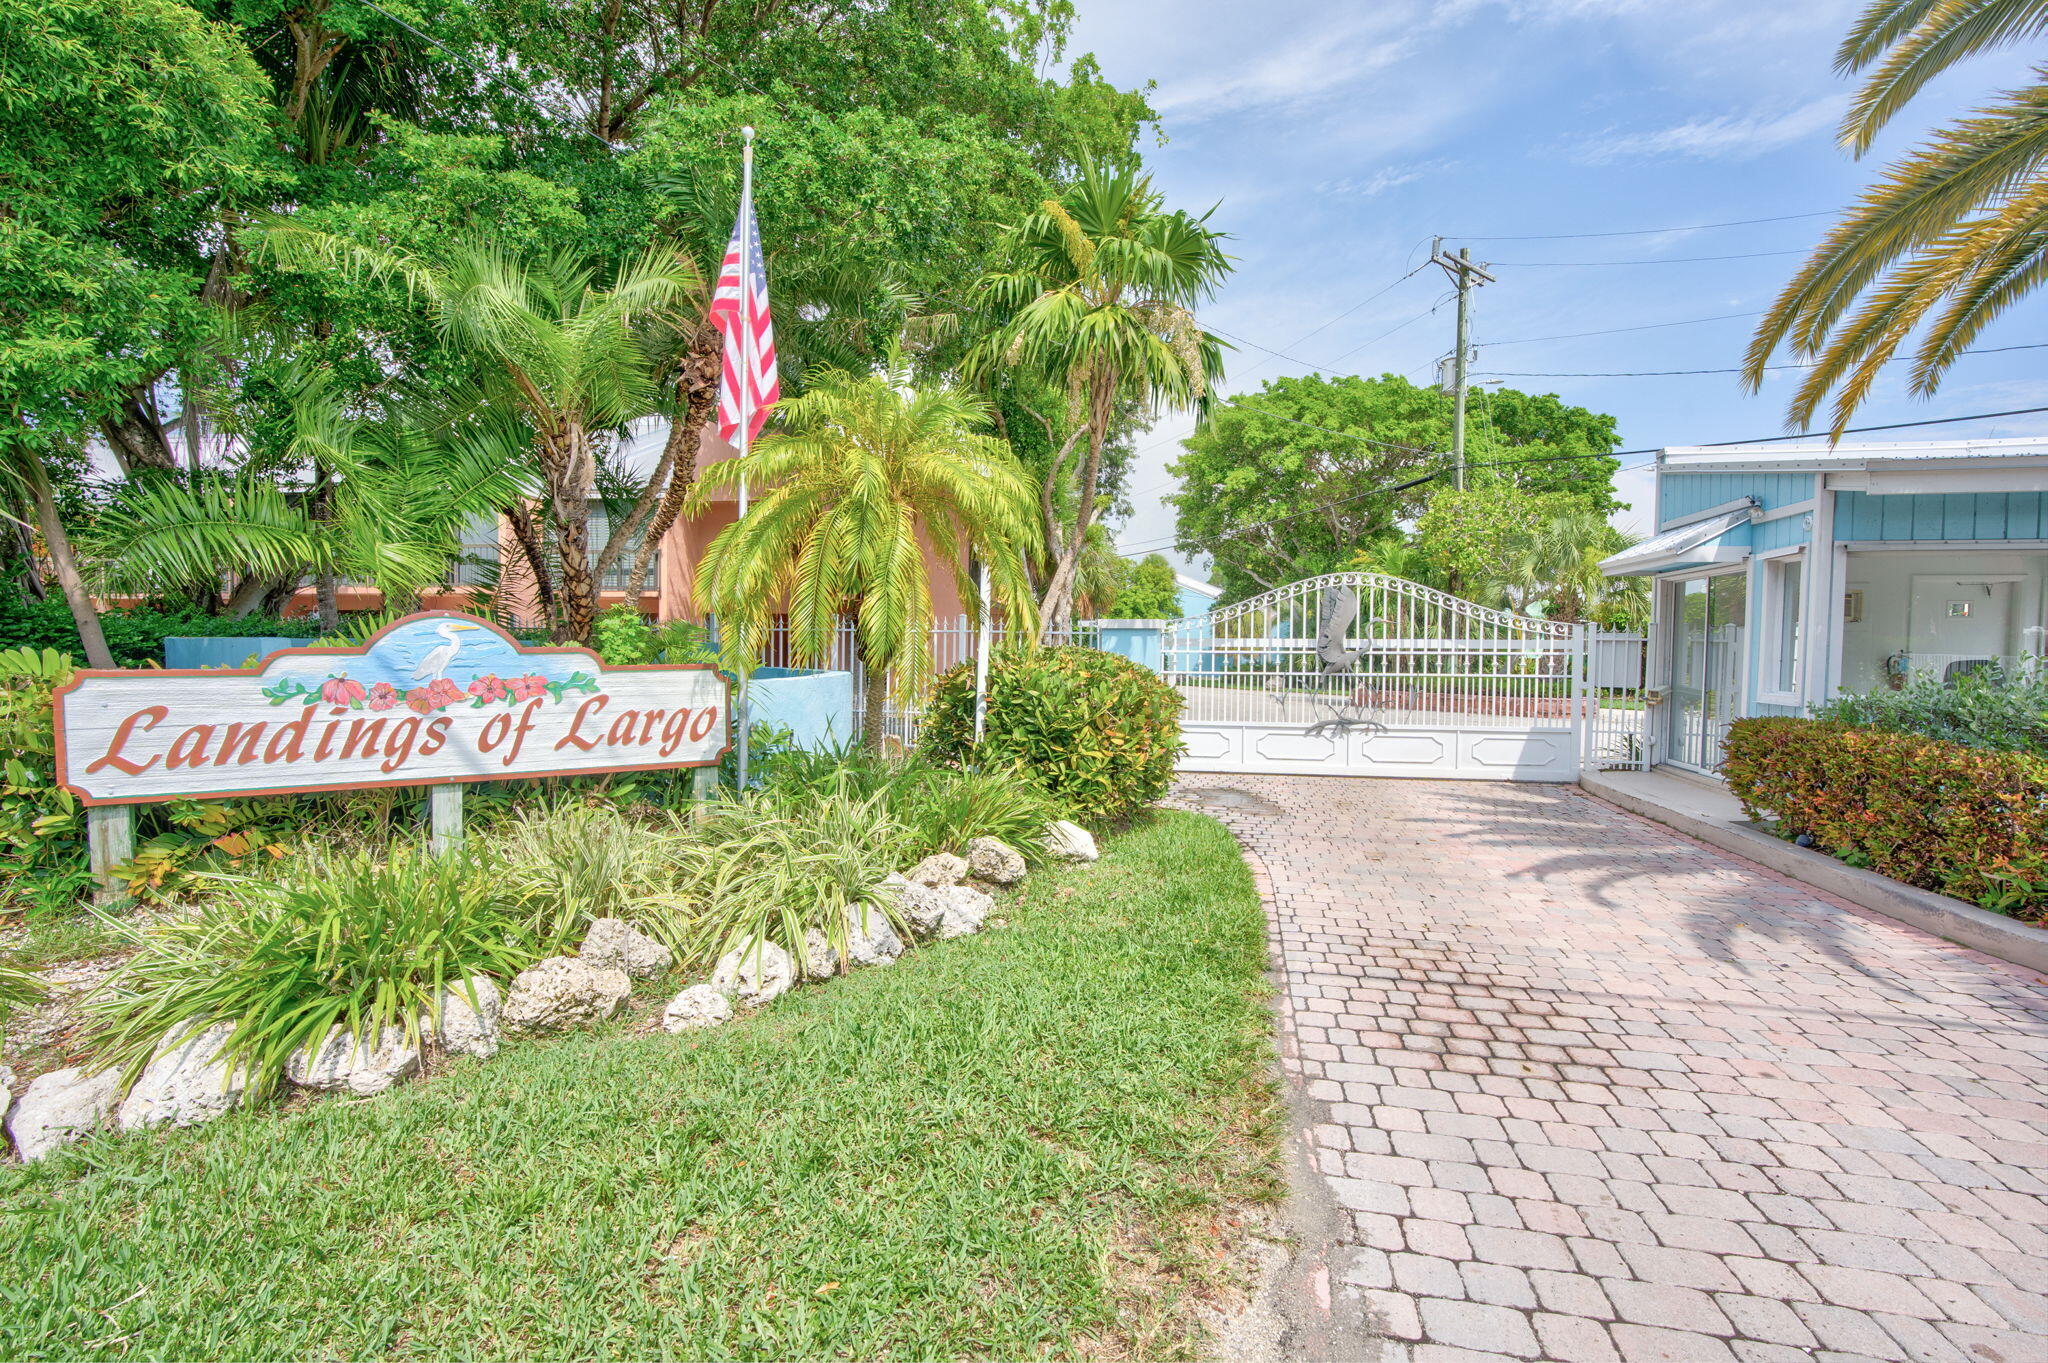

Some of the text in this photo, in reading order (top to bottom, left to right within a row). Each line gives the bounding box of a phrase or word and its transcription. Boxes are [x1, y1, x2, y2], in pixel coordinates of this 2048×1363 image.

[86, 695, 717, 774] Landings of Largo
